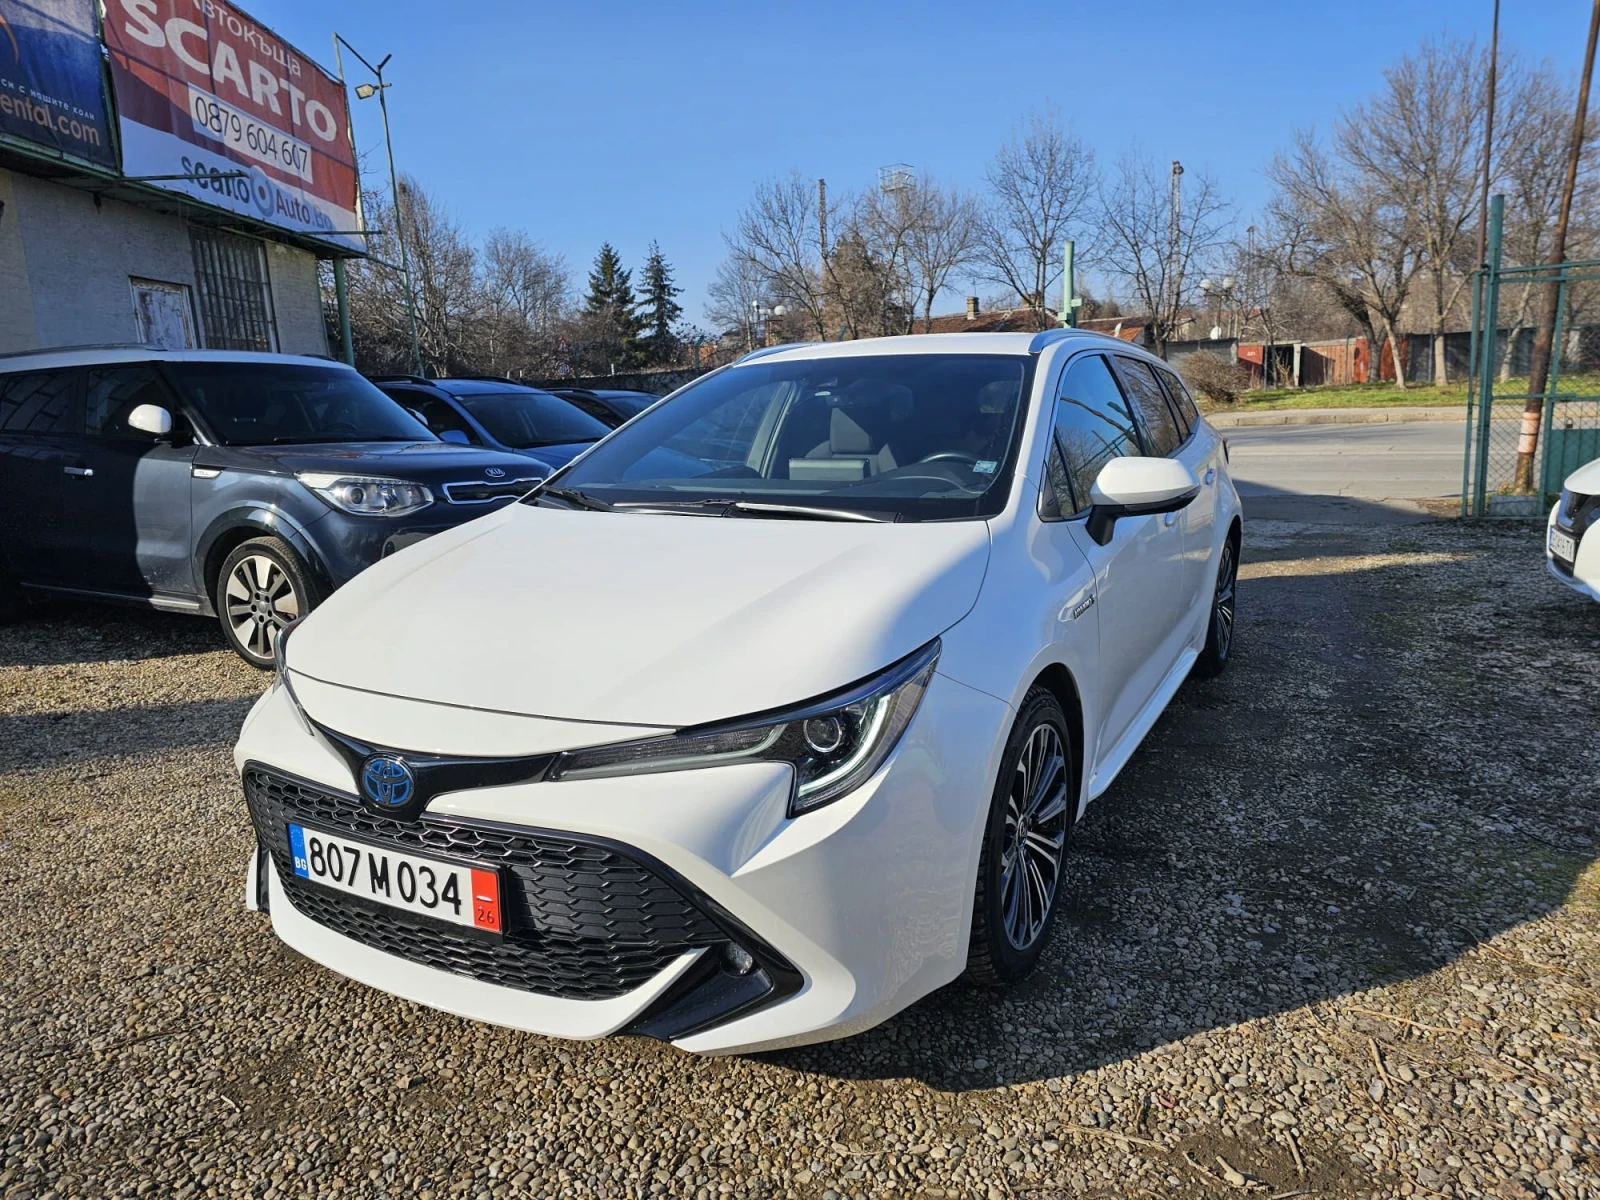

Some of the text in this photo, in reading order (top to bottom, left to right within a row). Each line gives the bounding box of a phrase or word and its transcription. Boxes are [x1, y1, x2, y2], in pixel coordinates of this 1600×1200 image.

[121, 0, 337, 142] SCARTO
[30, 89, 69, 111] нашите
[73, 106, 95, 121] коли
[195, 96, 308, 173] 0879 604 607
[488, 467, 505, 476] KIA
[295, 856, 307, 871] BG
[309, 837, 462, 916] 807 M 034
[477, 909, 495, 924] 26
